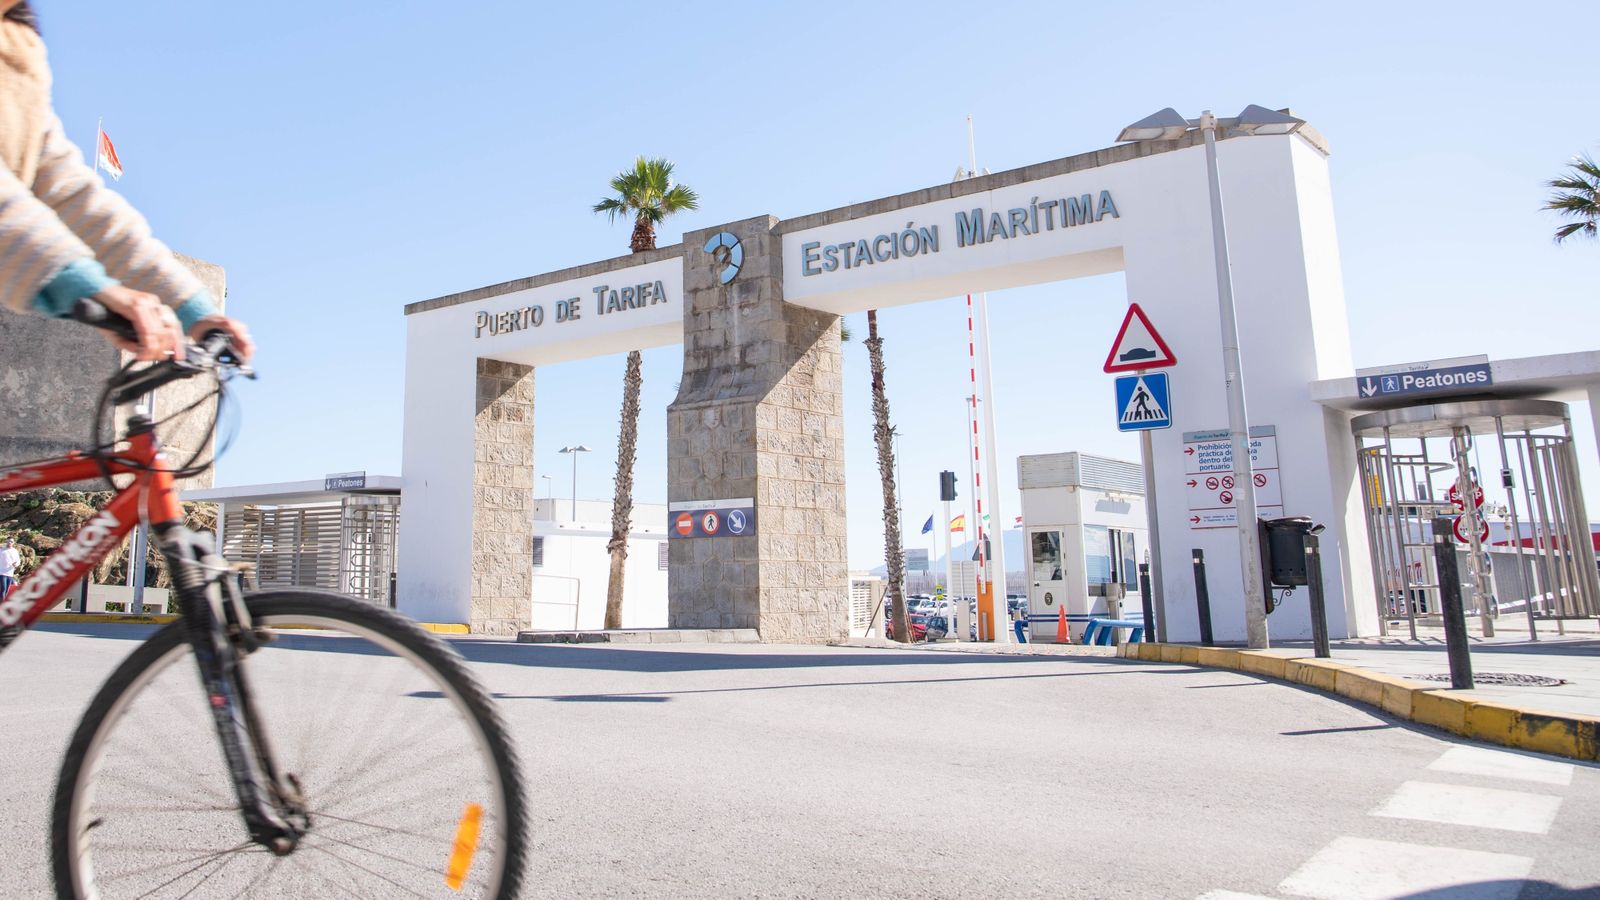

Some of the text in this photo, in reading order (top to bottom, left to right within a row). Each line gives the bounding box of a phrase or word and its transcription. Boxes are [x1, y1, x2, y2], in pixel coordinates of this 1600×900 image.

[474, 280, 668, 338] PUERTO DE TARIFA
[1402, 370, 1488, 390] Peatones
[1199, 463, 1230, 471] portuario
[338, 479, 363, 488] Peatones
[1451, 491, 1482, 500] SP
